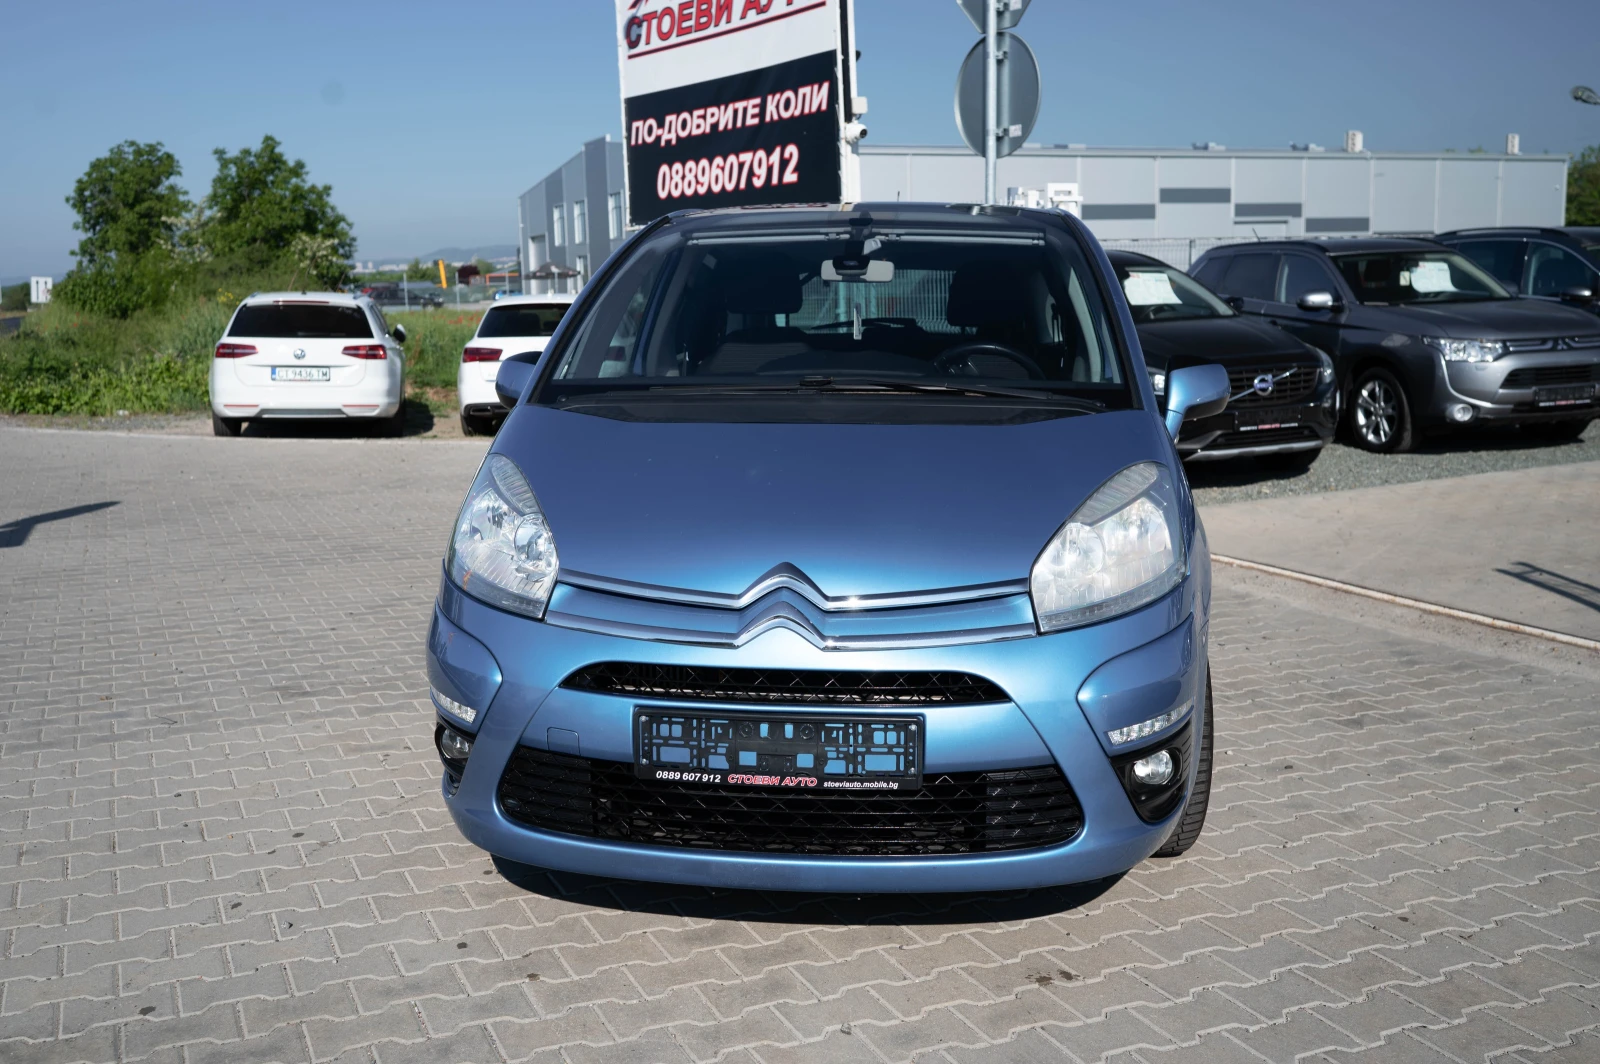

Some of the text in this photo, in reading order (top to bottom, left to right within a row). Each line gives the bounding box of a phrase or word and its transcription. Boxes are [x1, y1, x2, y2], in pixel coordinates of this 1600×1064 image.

[626, 0, 732, 49] СТОЕВИ
[630, 81, 830, 147] ПО-ДОБРИТЕ КОЛИ
[657, 143, 799, 200] 0889607912
[655, 770, 899, 790] 0889 607 912 СТОЕВИ АУТО stoeviauto.mobile.bg
